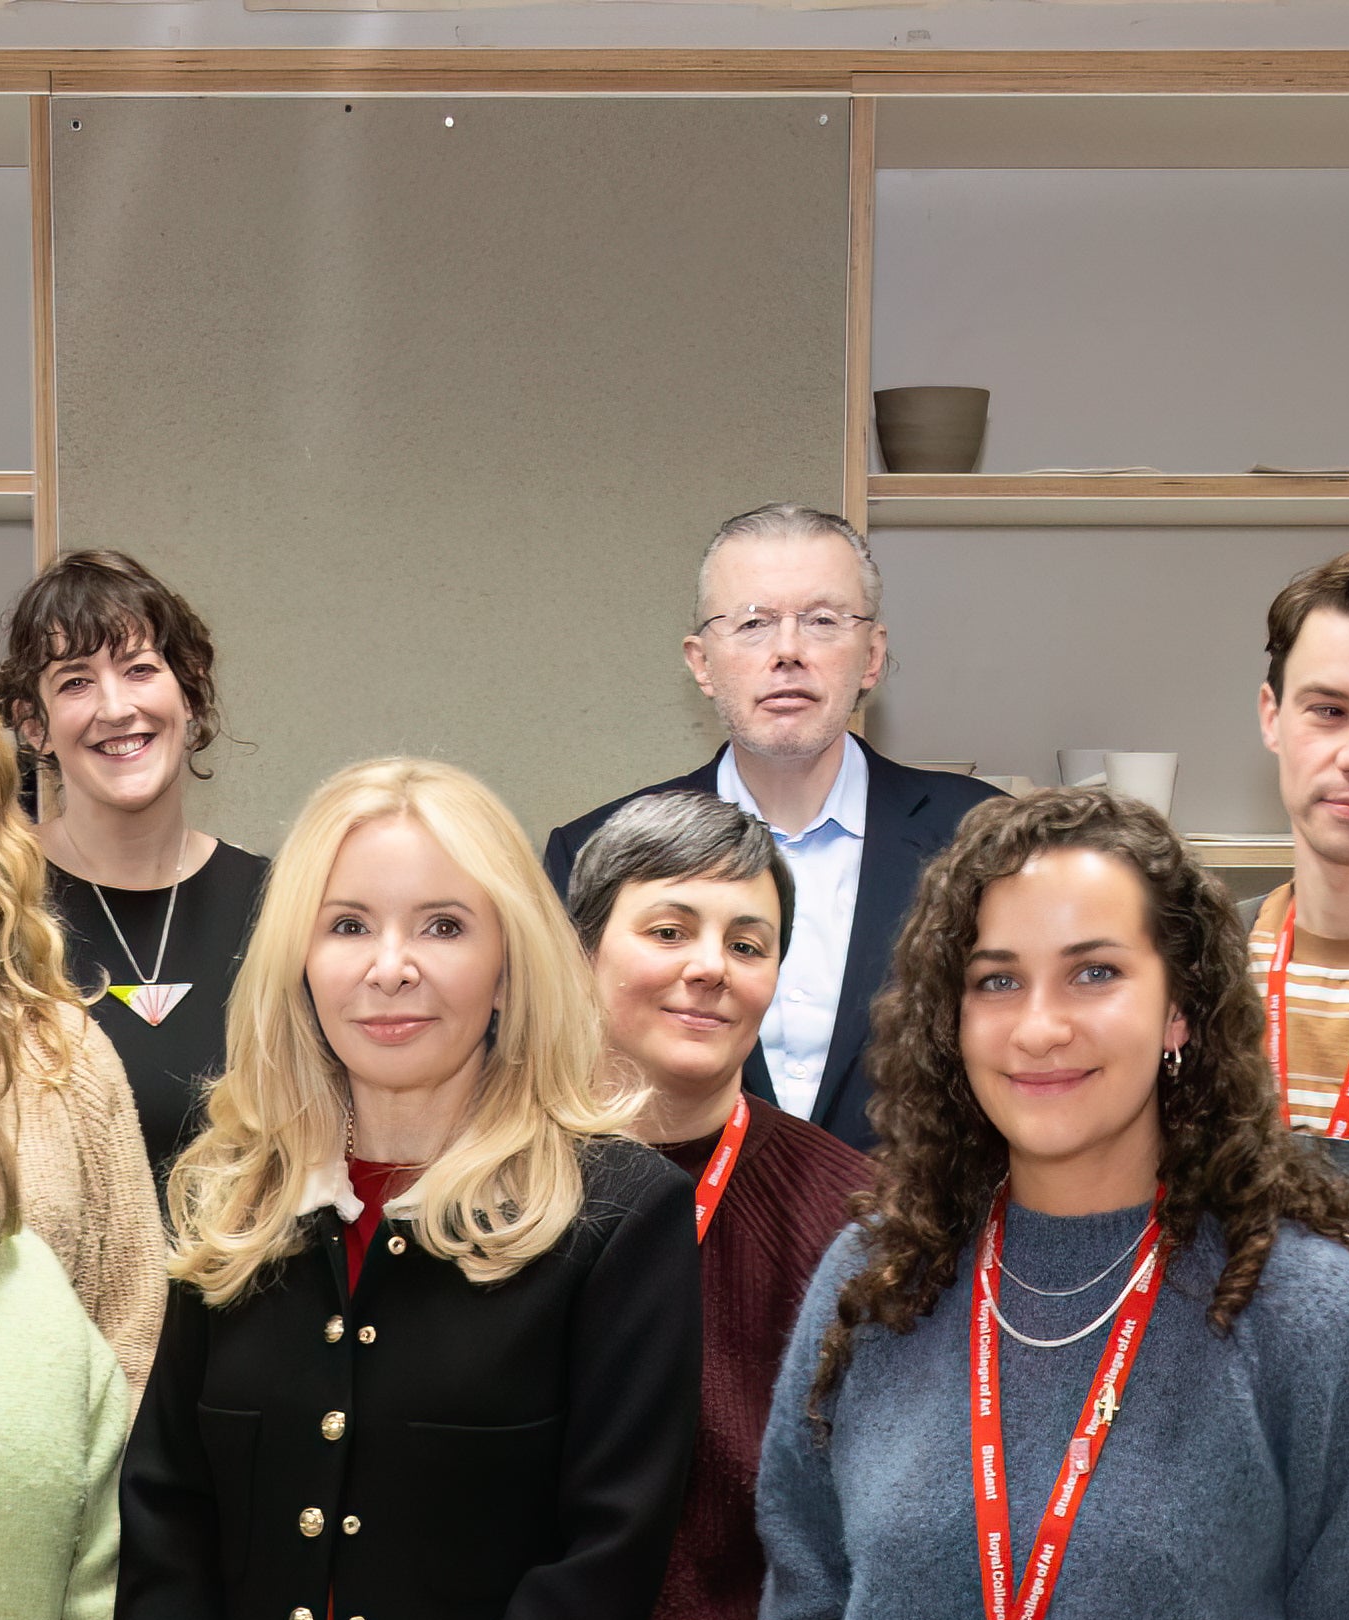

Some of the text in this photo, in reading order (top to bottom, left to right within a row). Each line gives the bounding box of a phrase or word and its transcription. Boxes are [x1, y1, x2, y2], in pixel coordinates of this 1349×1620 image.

[1120, 1319, 1137, 1340] Art
[977, 1334, 992, 1384] College
[979, 1398, 992, 1417] Art
[981, 1445, 997, 1501] Student
[987, 1532, 1004, 1569] Royal
[1039, 1543, 1056, 1564] Art
[1036, 1561, 1049, 1578] of
